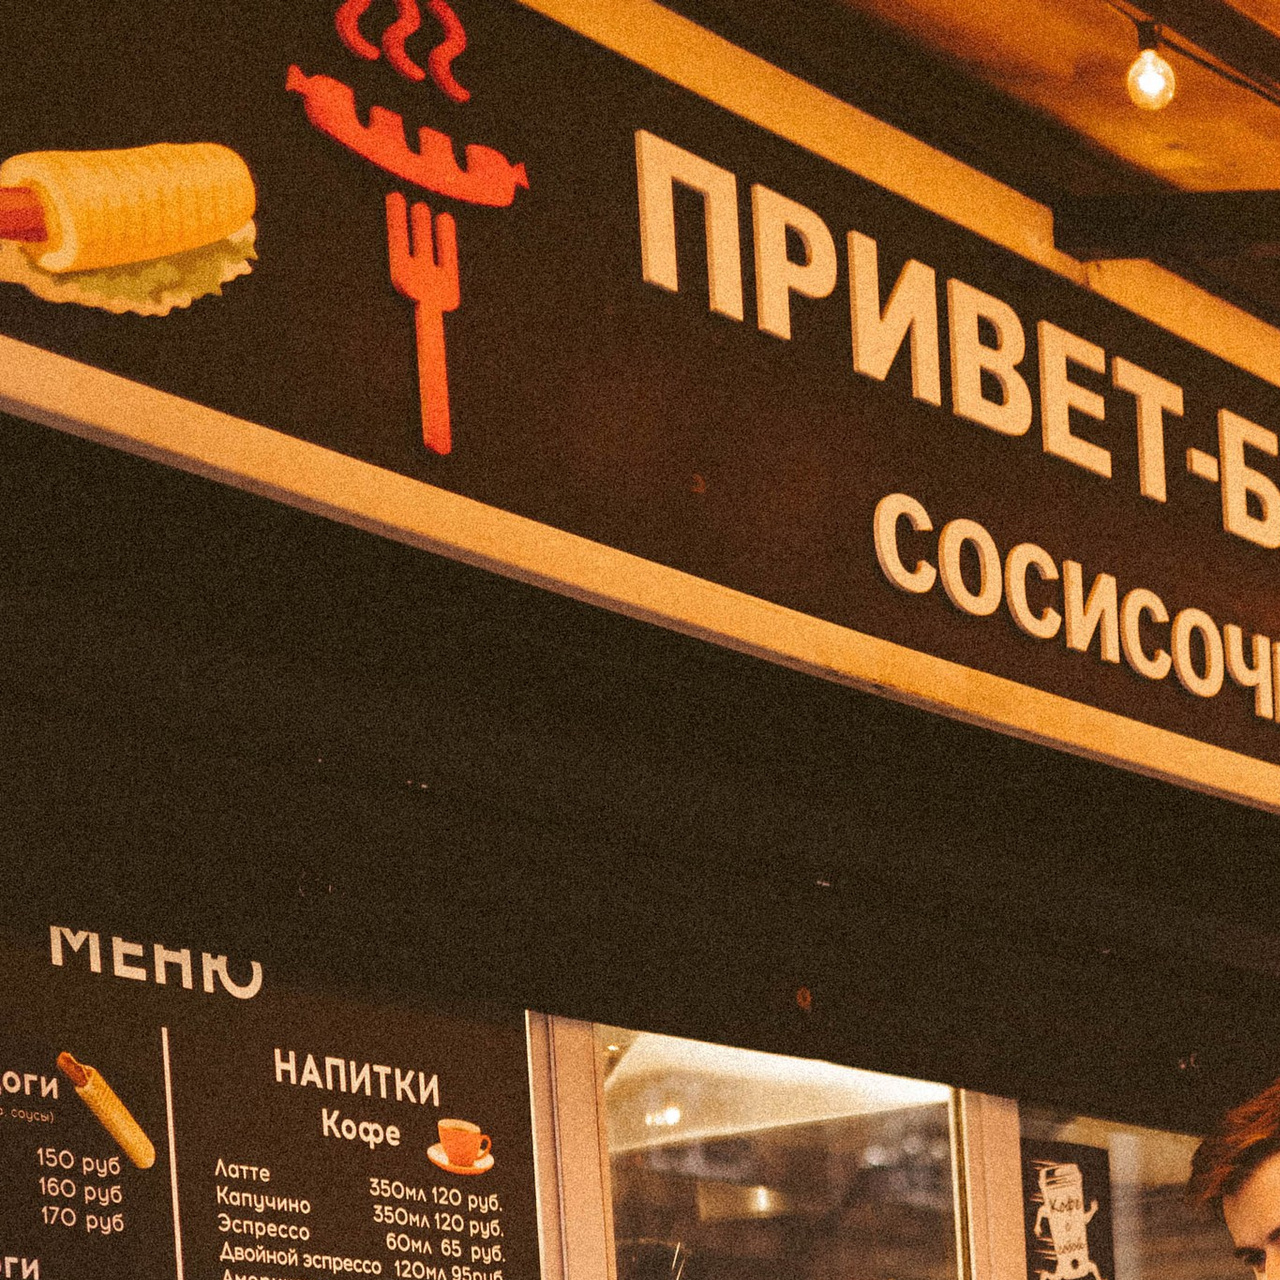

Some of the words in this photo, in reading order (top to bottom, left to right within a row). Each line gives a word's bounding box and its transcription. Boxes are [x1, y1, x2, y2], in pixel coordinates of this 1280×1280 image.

[50, 925, 263, 1000] МЕНЮ
[274, 1048, 440, 1107] НАПИТКИ
[321, 1107, 401, 1150] Кофе
[37, 1147, 74, 1169] 150
[82, 1156, 120, 1178] руб
[215, 1158, 271, 1182] Латте
[369, 1178, 427, 1202] 350мл
[431, 1186, 462, 1207] 120
[468, 1191, 503, 1214] руб.
[38, 1177, 76, 1198] 160
[84, 1186, 123, 1206] руб
[216, 1186, 311, 1214] Капучино
[373, 1204, 430, 1229] 350мл
[434, 1213, 464, 1233] 120
[469, 1217, 504, 1239] руб.
[41, 1206, 76, 1227] 170
[86, 1214, 124, 1235] руб
[218, 1213, 310, 1240] Эспрессо
[386, 1233, 432, 1255] 60мл
[441, 1240, 462, 1258] 65
[471, 1242, 507, 1265] руб.
[220, 1241, 298, 1268] Двойной
[303, 1254, 382, 1277] эспрессо
